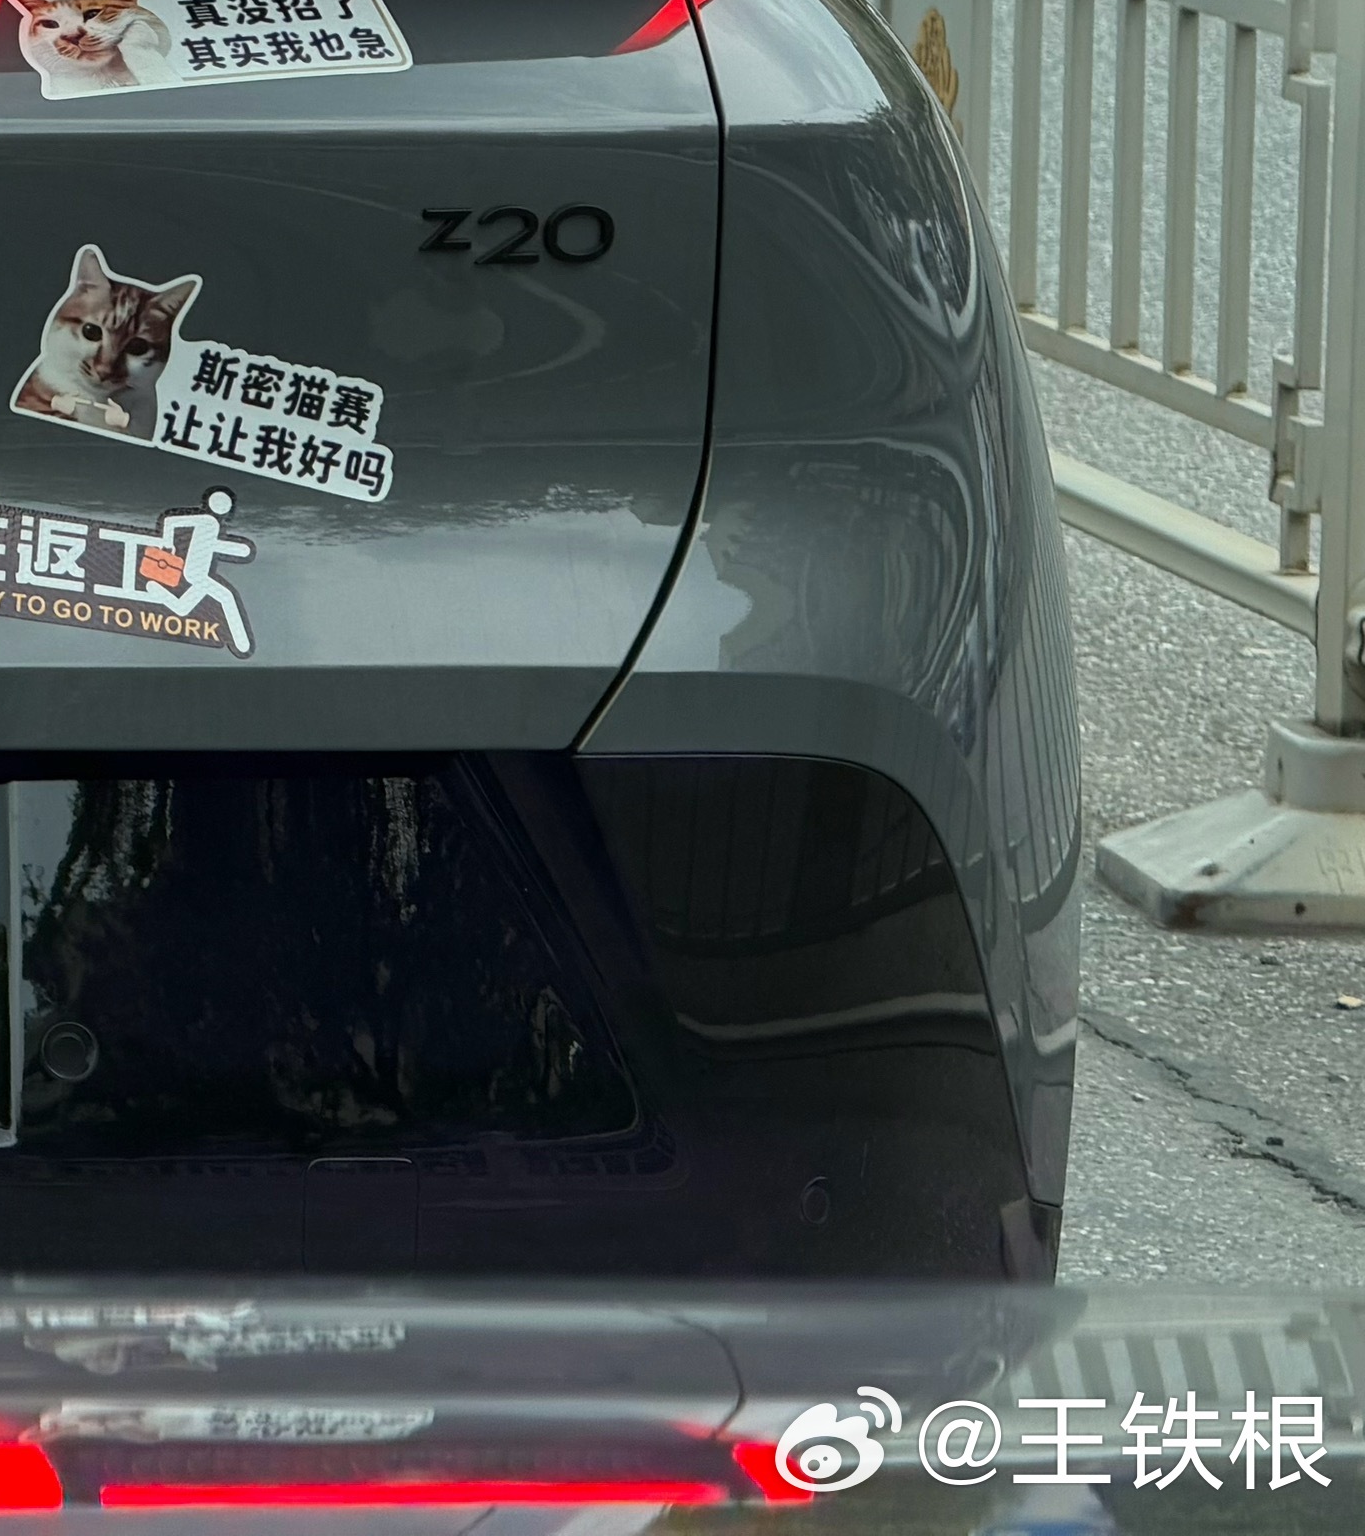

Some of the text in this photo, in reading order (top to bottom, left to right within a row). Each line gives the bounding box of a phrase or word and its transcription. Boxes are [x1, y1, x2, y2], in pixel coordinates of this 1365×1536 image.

[180, 27, 395, 71] 其实我也急
[191, 349, 374, 434] 斯密猫赛
[161, 400, 386, 497] 让让我好吗
[12, 591, 45, 615] TO
[53, 597, 92, 623] GO
[98, 604, 133, 629] TO
[139, 610, 221, 642] WORK
